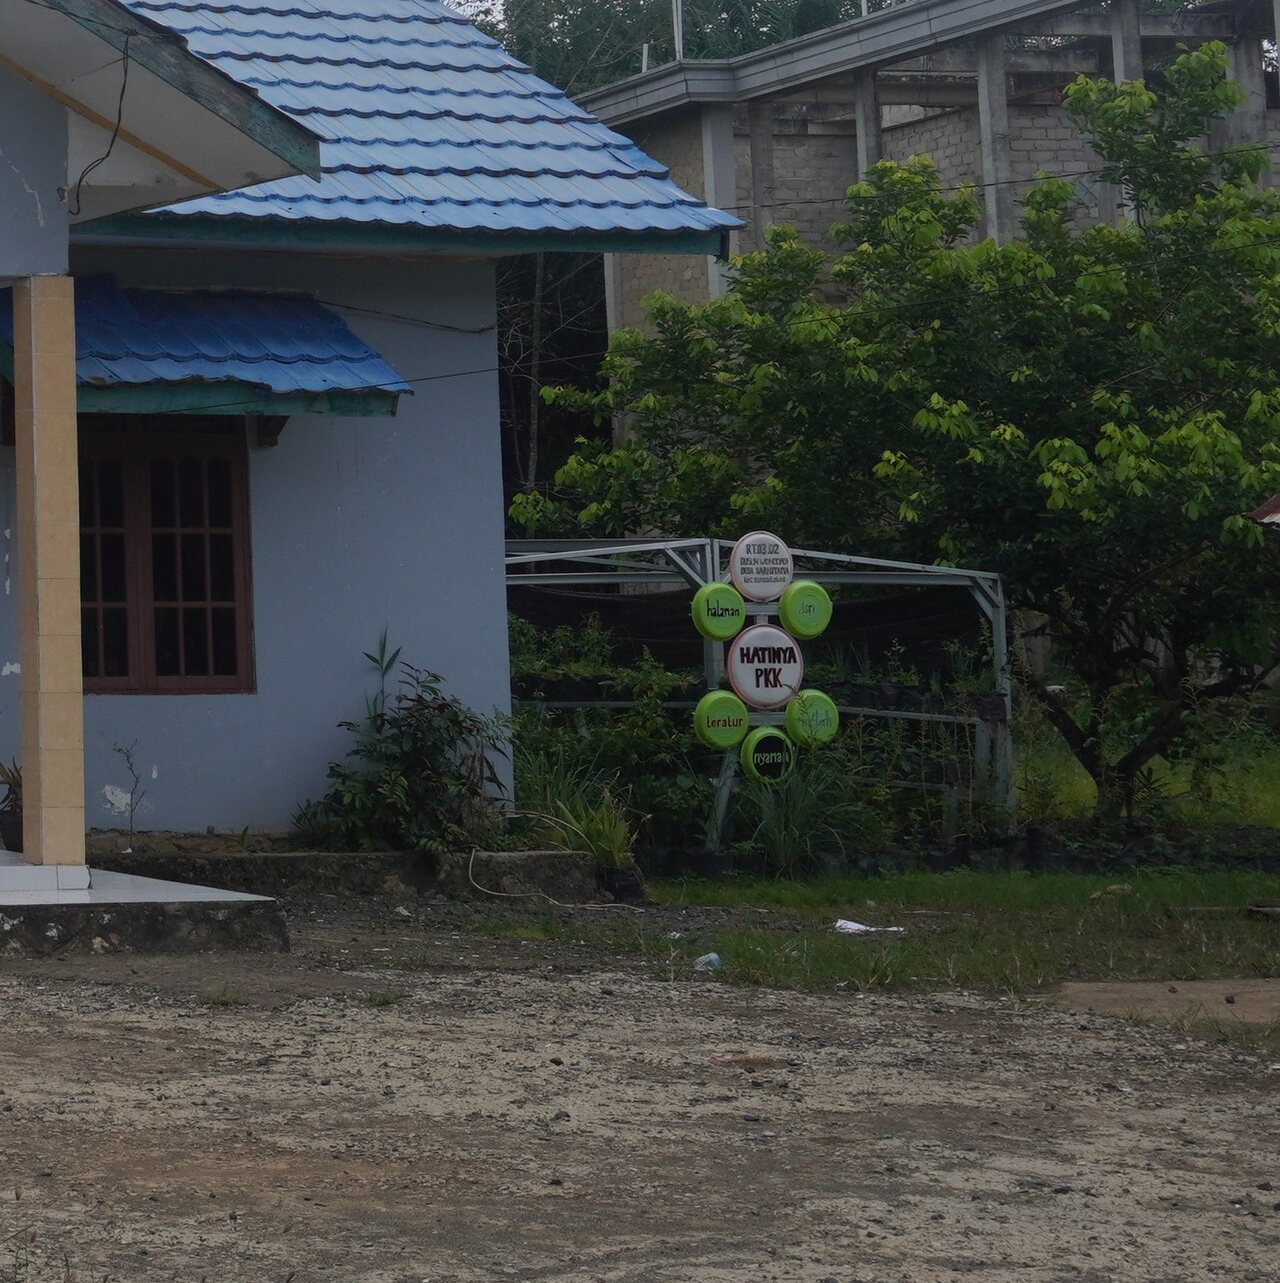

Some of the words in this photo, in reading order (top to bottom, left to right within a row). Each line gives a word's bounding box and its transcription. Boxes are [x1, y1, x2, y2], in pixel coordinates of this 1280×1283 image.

[706, 600, 740, 618] halaman
[740, 646, 797, 665] HATINYA
[755, 667, 783, 688] PKK
[706, 716, 744, 729] teratur
